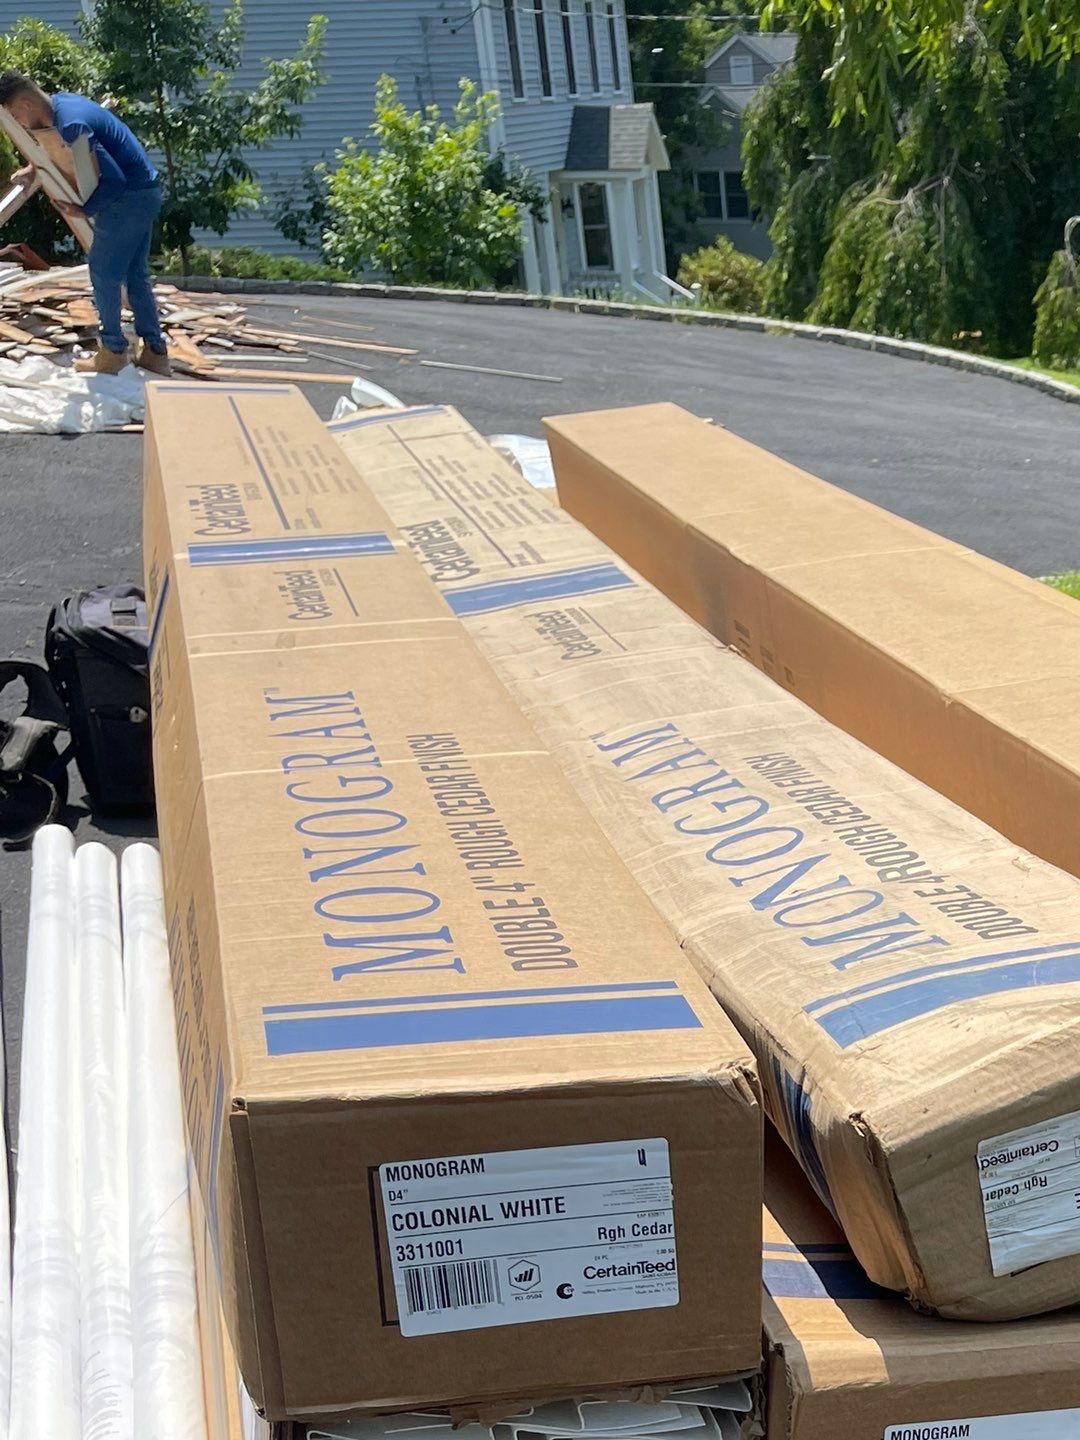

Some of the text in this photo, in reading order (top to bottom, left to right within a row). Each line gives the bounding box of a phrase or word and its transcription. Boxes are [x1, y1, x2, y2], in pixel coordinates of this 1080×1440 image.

[274, 570, 332, 620] CertainTeed
[523, 610, 602, 660] CertainTeed
[742, 752, 822, 788] FINISH
[787, 786, 871, 825] CEDAR
[264, 691, 466, 981] MONOGRAM
[406, 732, 578, 971] DOUBLE 4" ROUGH CEDAR FINISH
[597, 722, 951, 971] MONOGRAM
[833, 824, 932, 883] ROUGH
[913, 885, 1038, 939] DOUBLE
[386, 1158, 485, 1182] MONOGRAM
[980, 1140, 1059, 1171] CertainTeed
[389, 1189, 408, 1201] D4"
[986, 1176, 1048, 1201] Rgh Cedar
[392, 1196, 566, 1232] COLONIAL WHITE
[598, 1222, 672, 1242] Rgh Cedar
[396, 1239, 463, 1261] 3311001
[584, 1258, 675, 1280] CertainTeed
